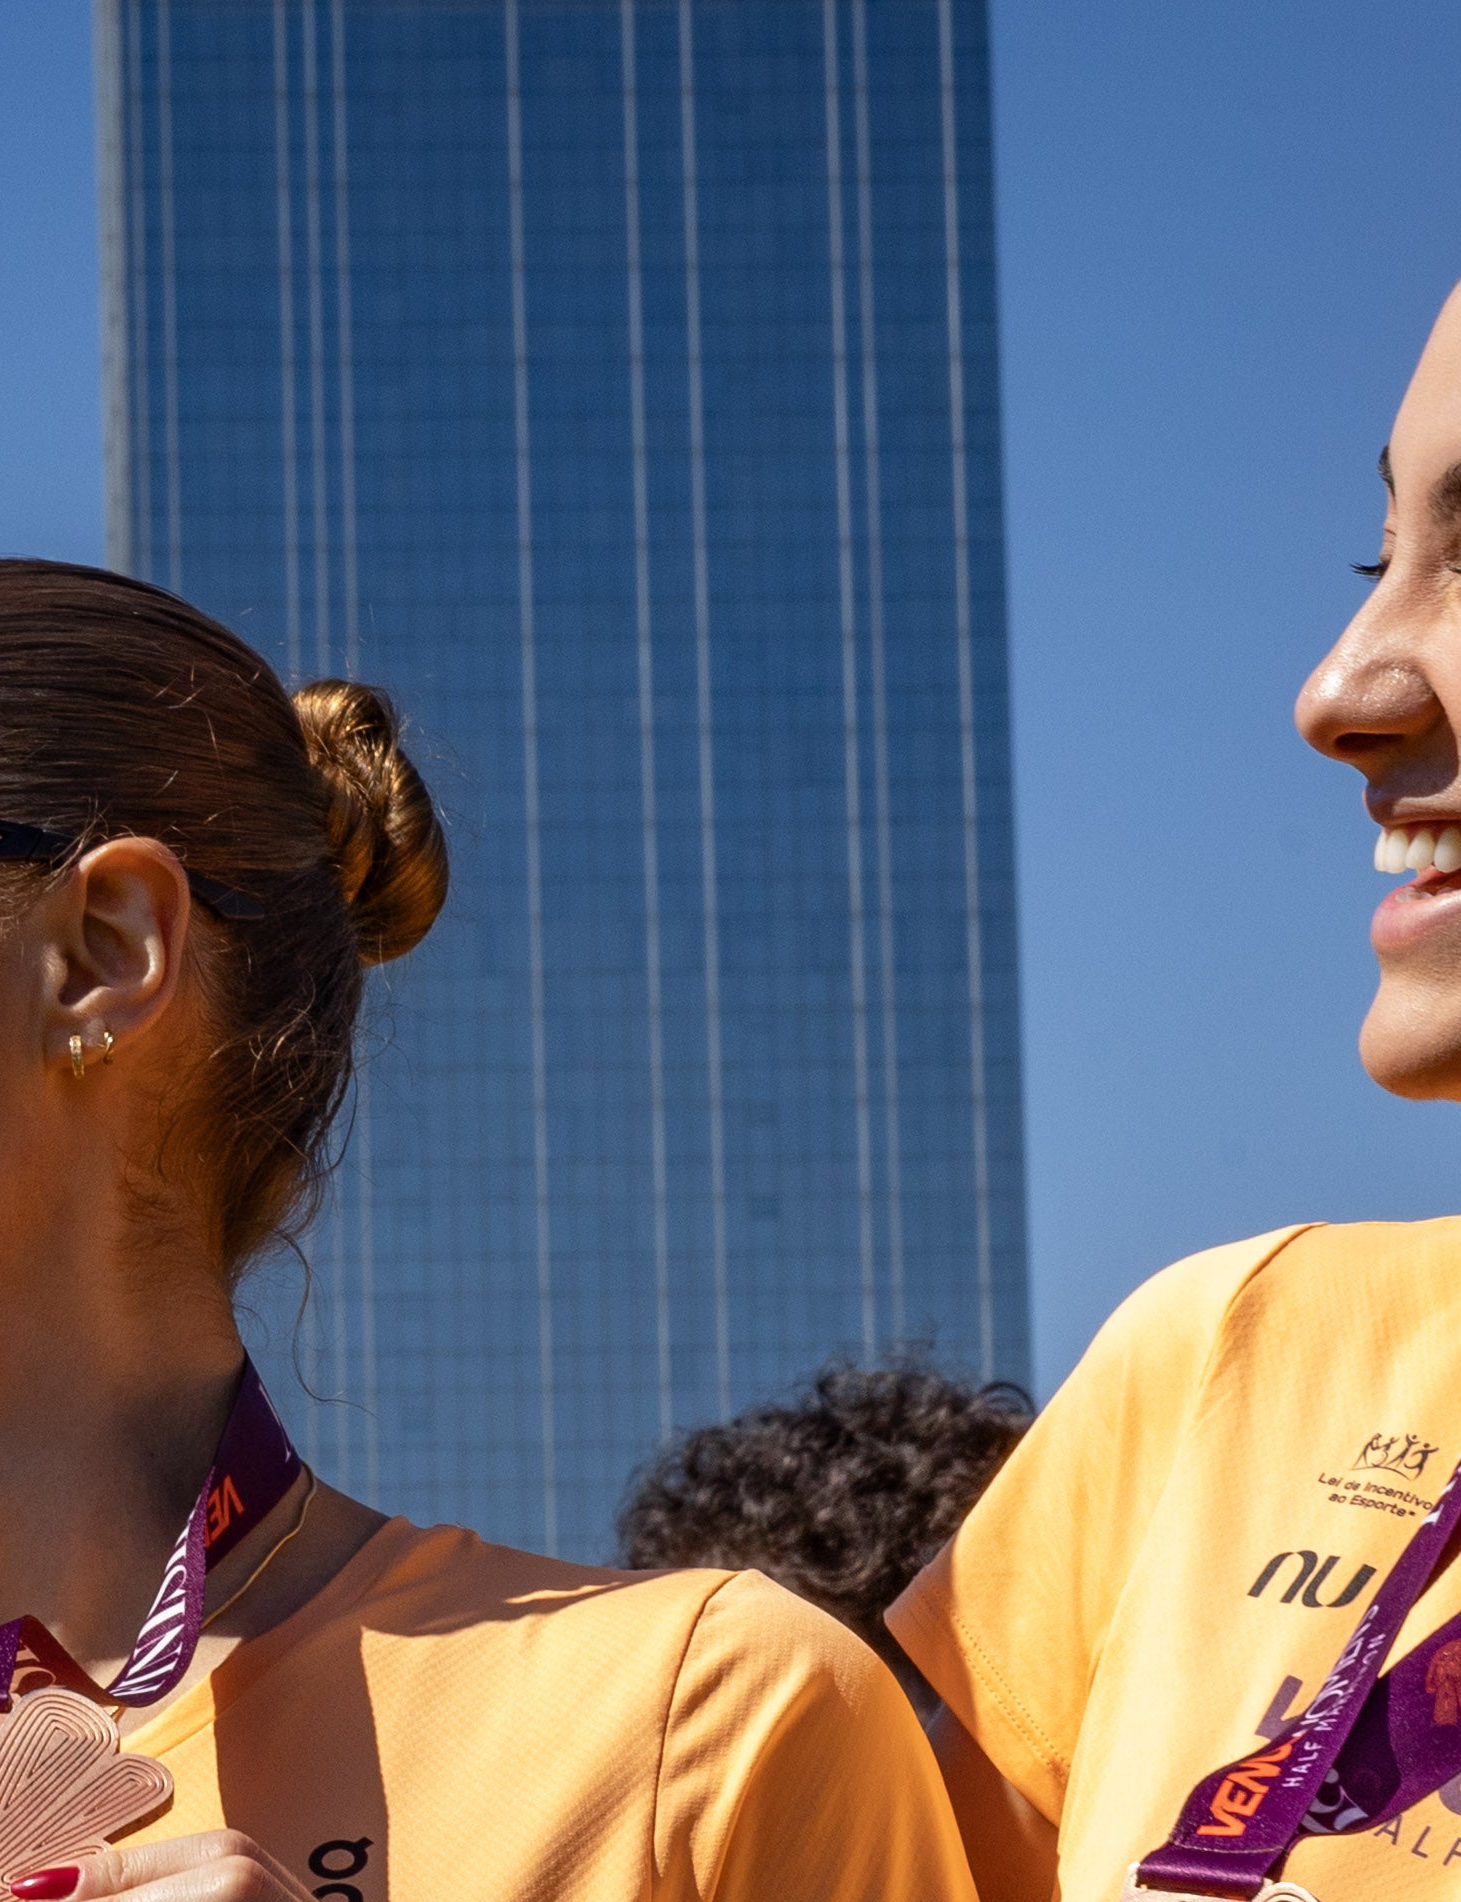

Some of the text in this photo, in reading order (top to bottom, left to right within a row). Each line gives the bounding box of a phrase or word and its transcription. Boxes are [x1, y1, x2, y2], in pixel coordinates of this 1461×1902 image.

[1317, 1472, 1434, 1511] Lei de Incentivo
[1328, 1492, 1407, 1518] ao Esporte
[1281, 1740, 1324, 1788] HALF
